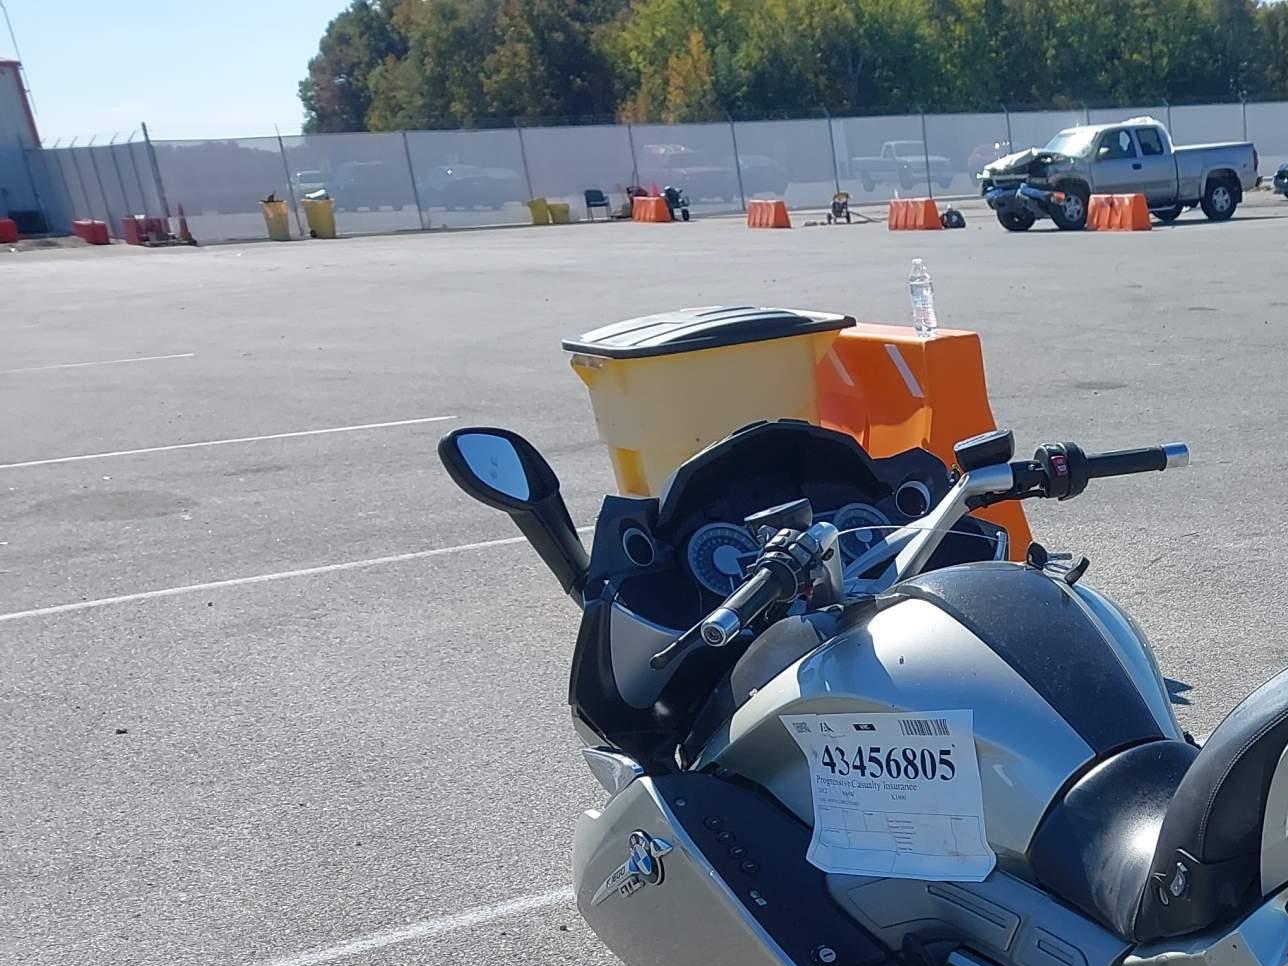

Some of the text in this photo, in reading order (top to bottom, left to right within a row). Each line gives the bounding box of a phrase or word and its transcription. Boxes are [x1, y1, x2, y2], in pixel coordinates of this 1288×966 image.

[821, 744, 956, 781] 43456805
[816, 774, 918, 792] Progressive Casualty Insurance
